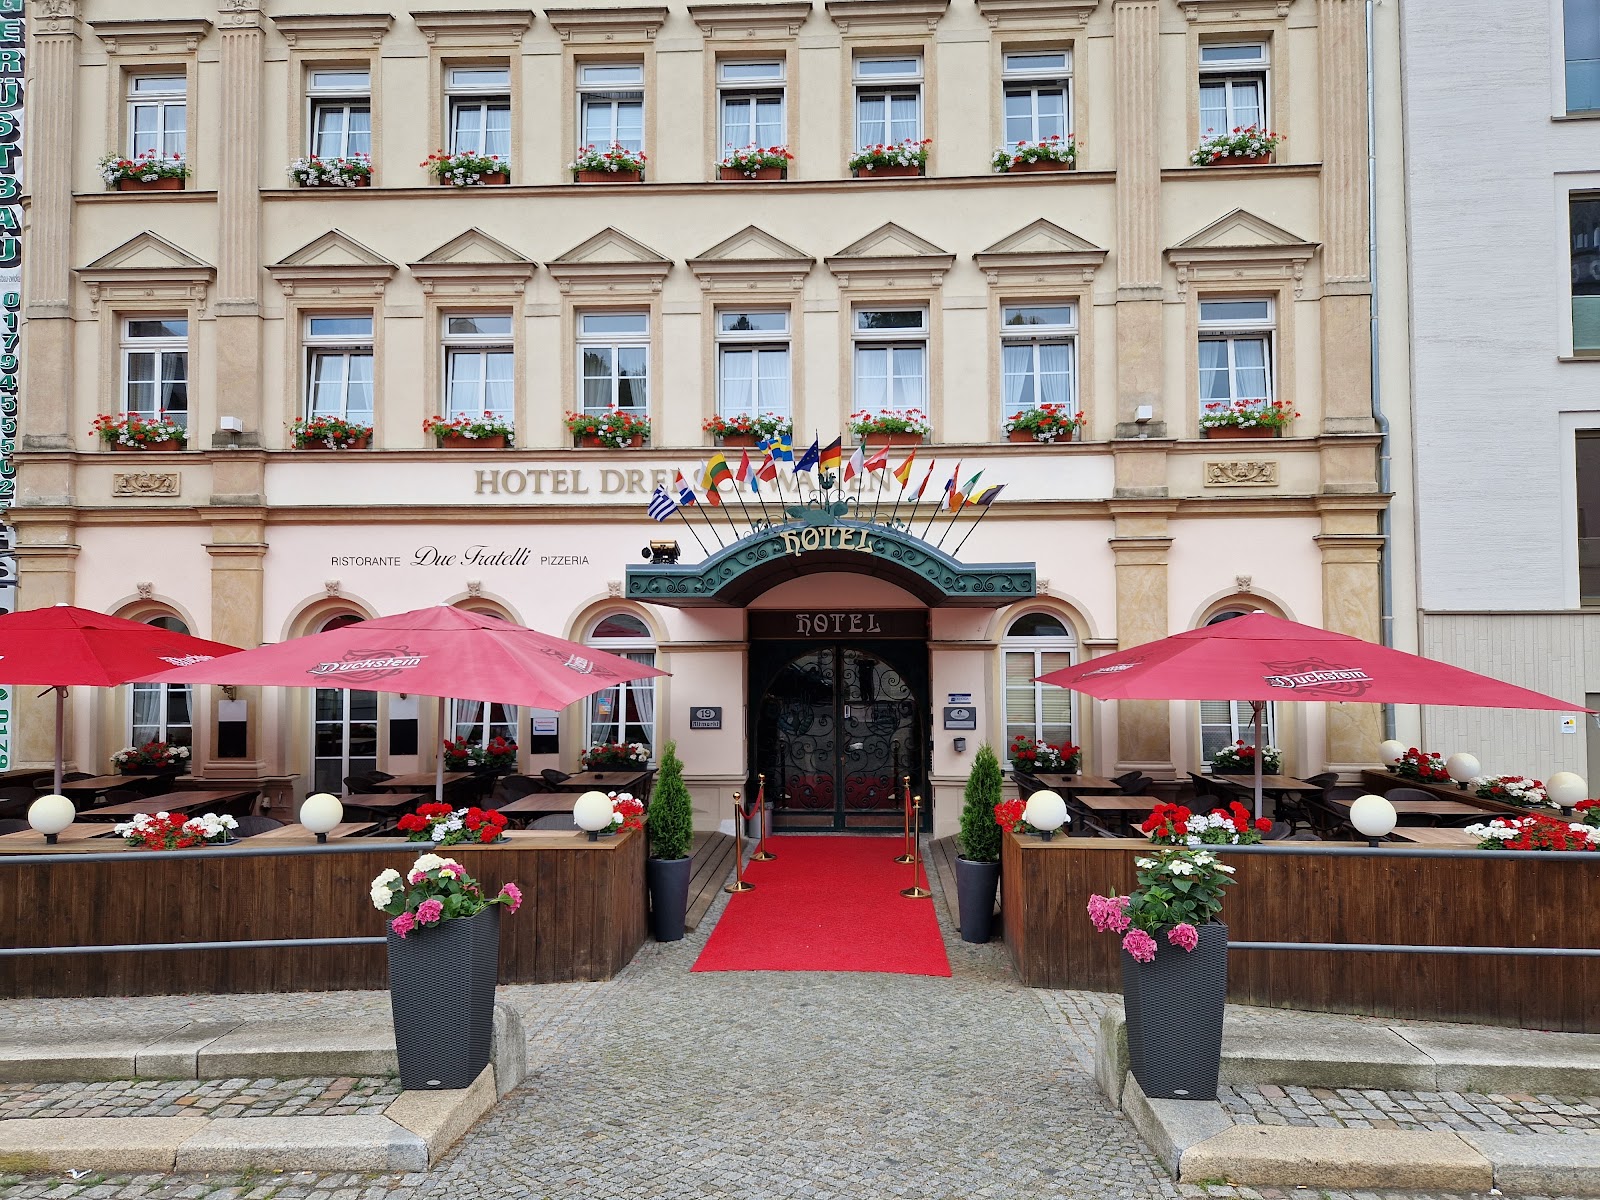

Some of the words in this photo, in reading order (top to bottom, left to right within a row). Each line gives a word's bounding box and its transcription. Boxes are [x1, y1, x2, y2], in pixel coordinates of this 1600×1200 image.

[474, 468, 589, 494] HOTEL
[780, 526, 874, 557] HOTEL
[331, 556, 401, 567] RISTORANTE
[410, 545, 457, 566] Due
[460, 544, 532, 566] Fratelli
[540, 555, 590, 566] PIZZERIA
[795, 613, 881, 637] HOTEL
[1269, 670, 1369, 688] Duckstein
[700, 709, 712, 718] 19
